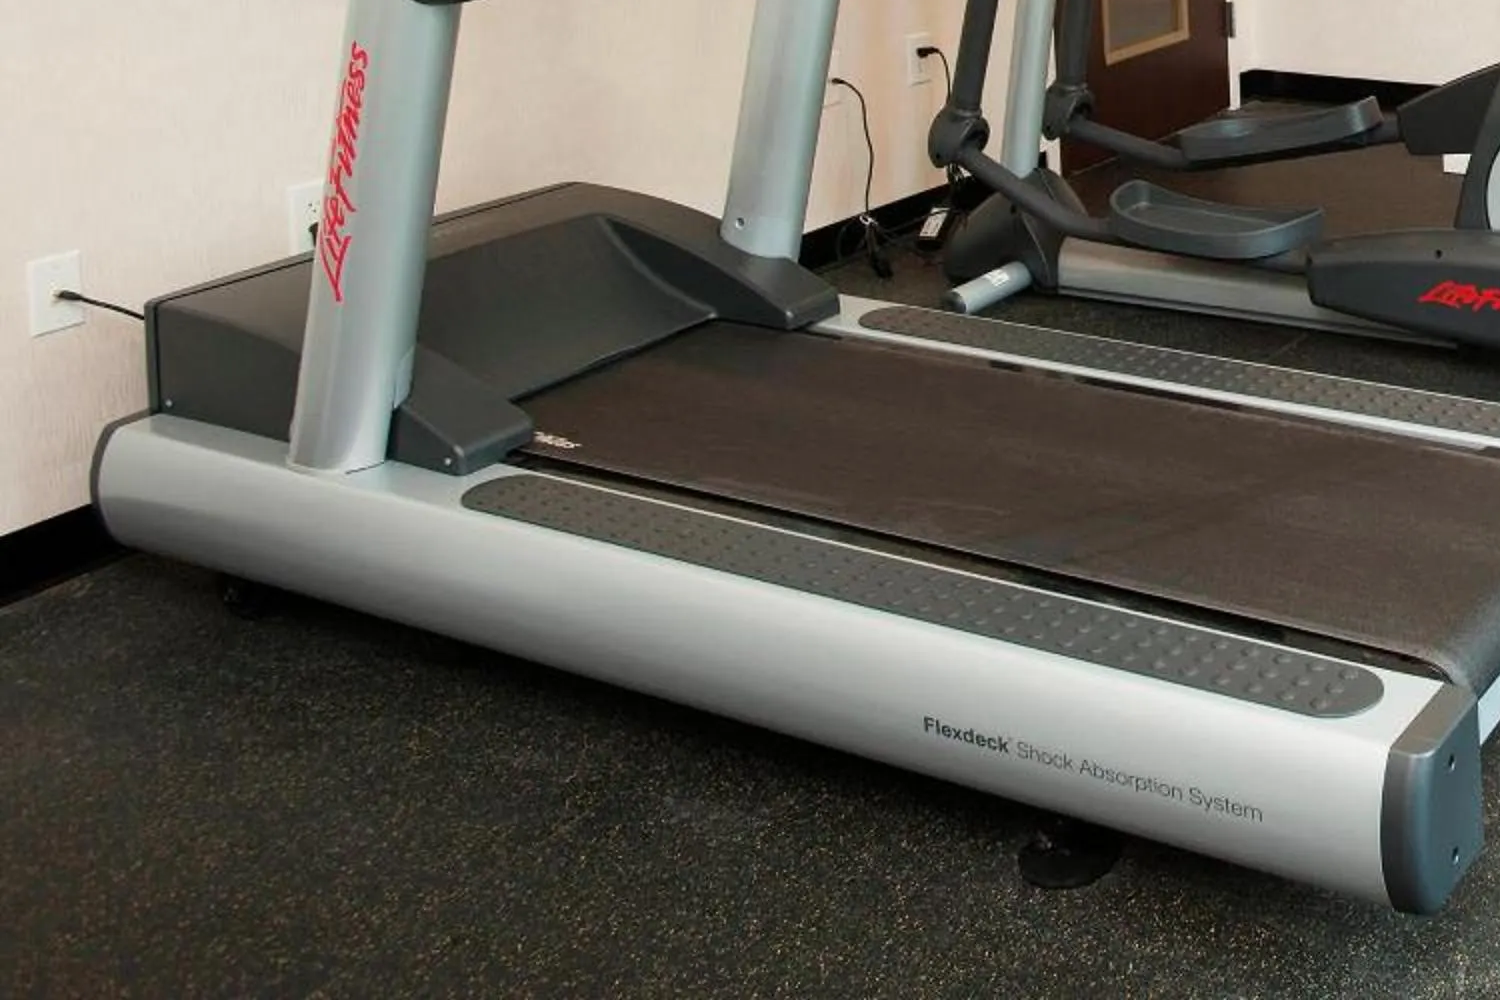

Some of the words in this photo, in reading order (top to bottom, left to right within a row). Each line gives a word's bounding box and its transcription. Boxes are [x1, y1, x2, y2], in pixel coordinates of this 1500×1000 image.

[922, 715, 1009, 754] Flexdeck
[1016, 740, 1075, 772] Shock
[1079, 758, 1184, 802] Absorption
[1188, 785, 1265, 823] System
